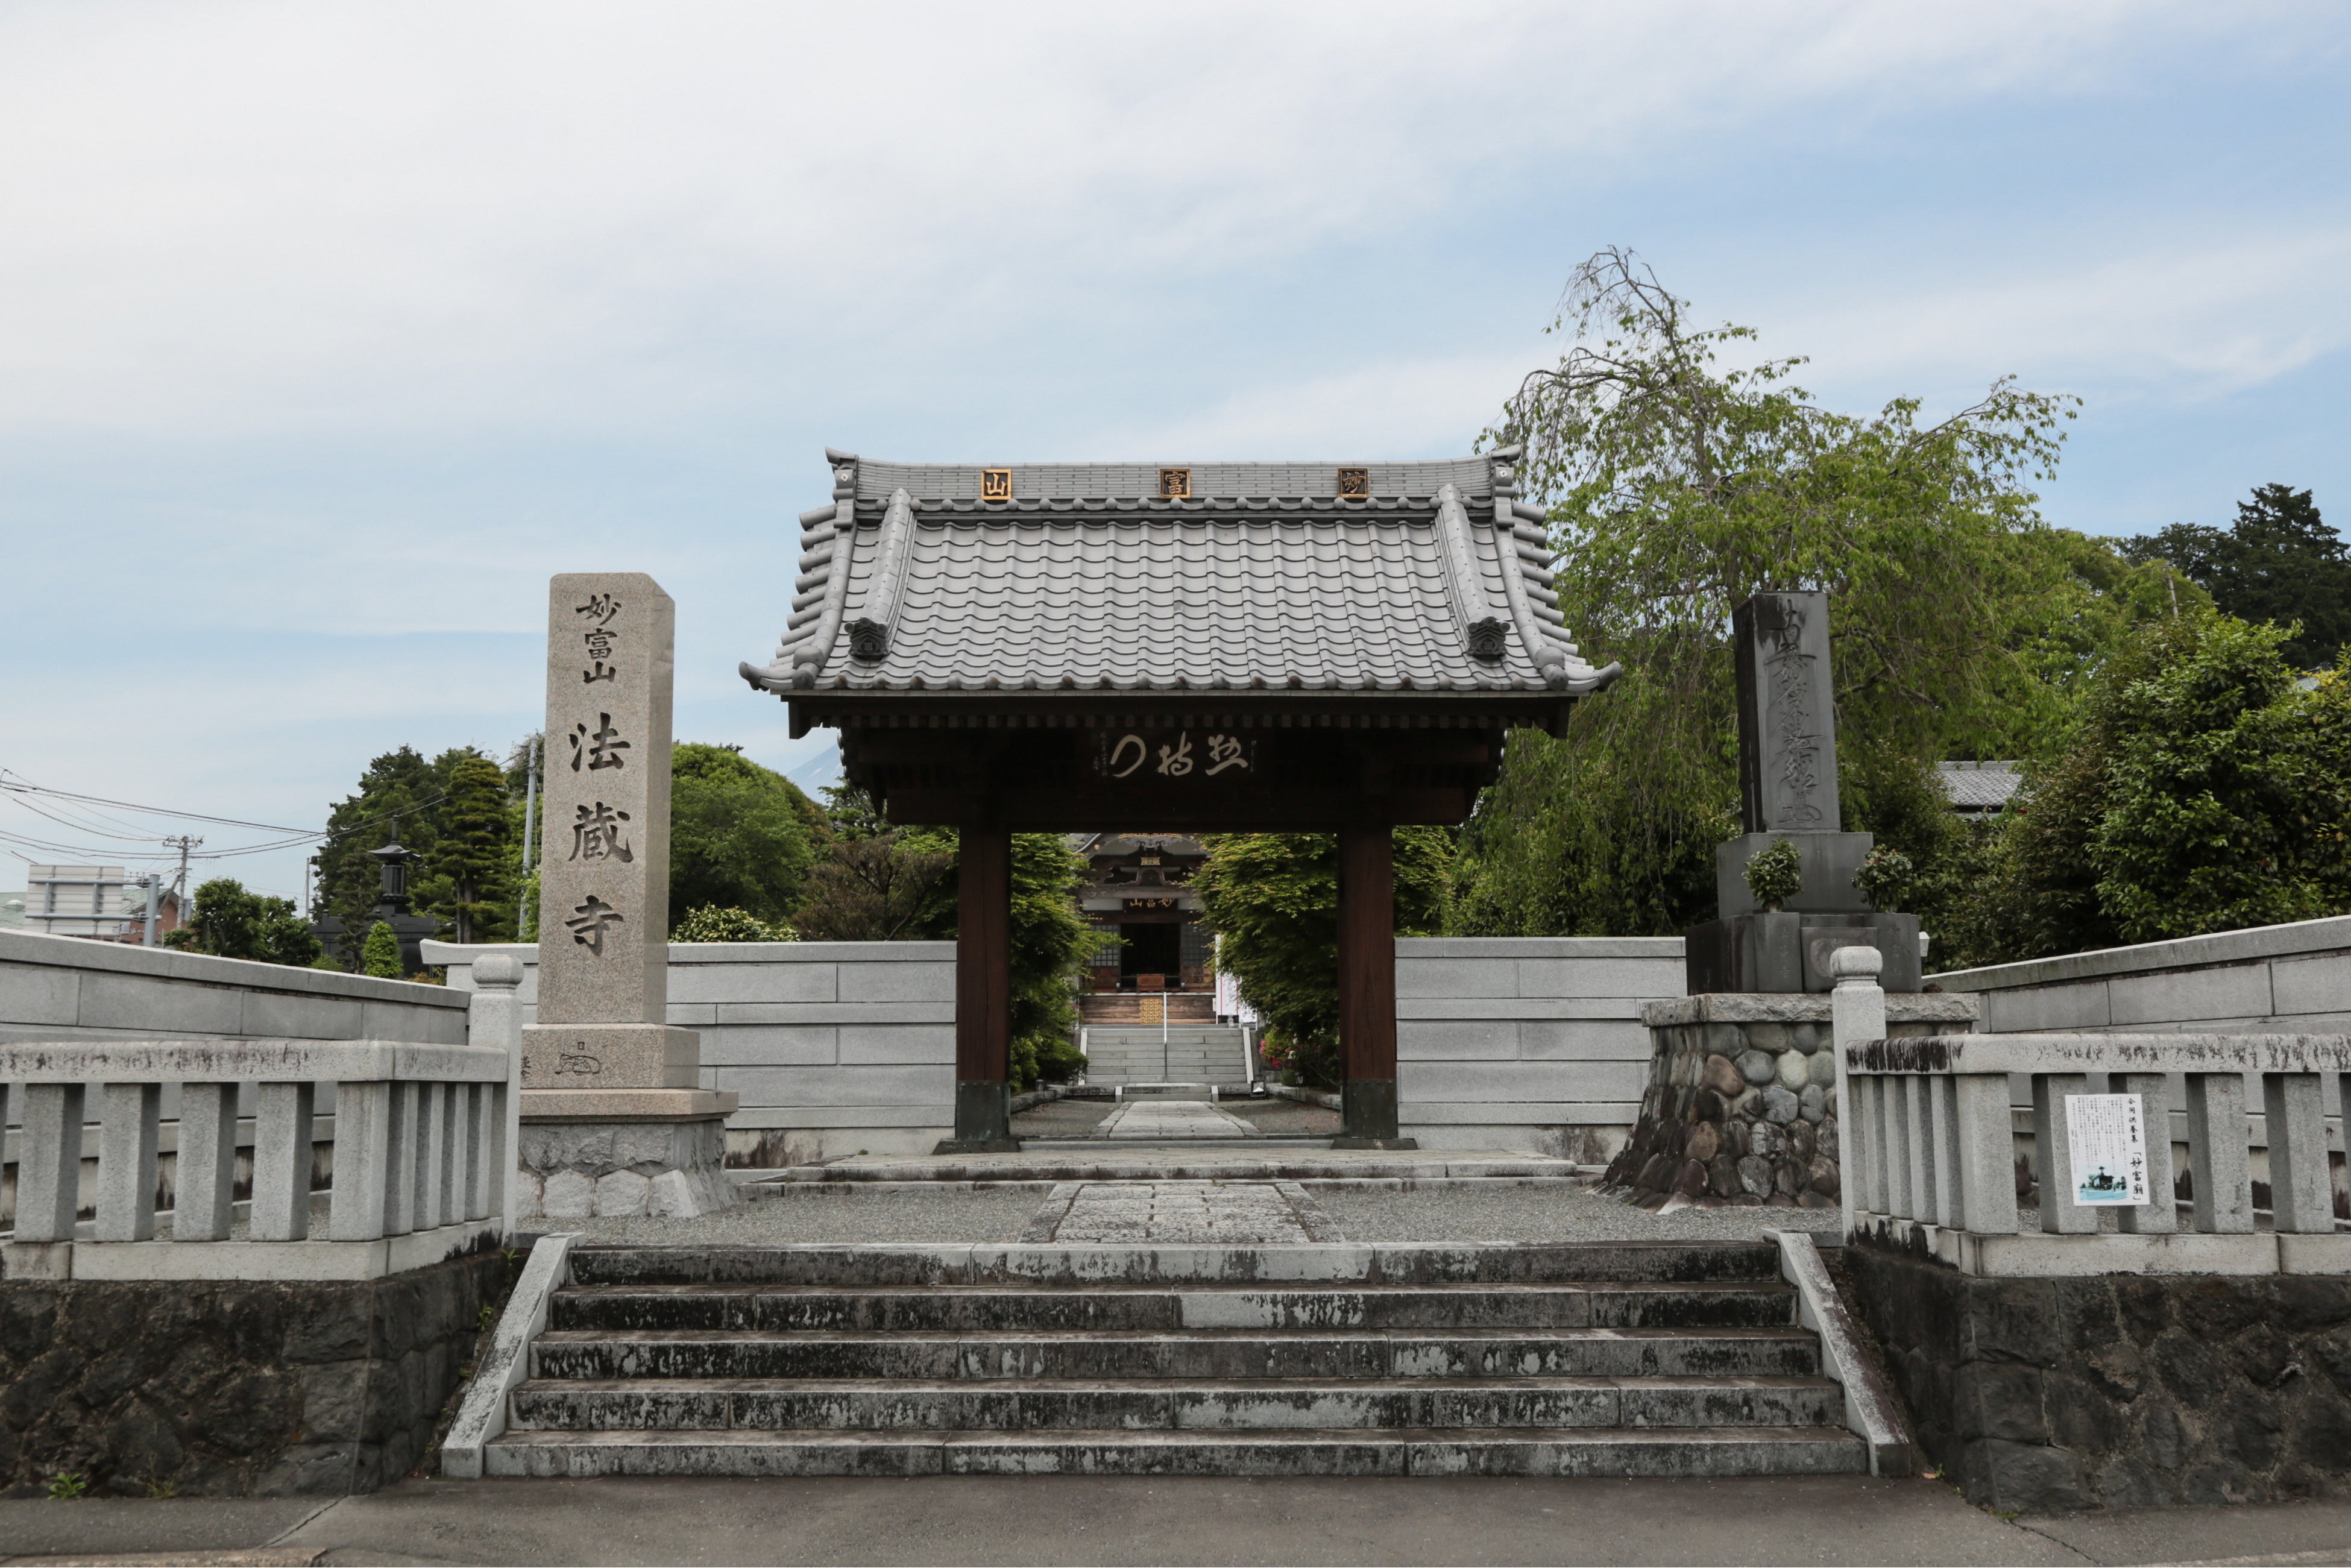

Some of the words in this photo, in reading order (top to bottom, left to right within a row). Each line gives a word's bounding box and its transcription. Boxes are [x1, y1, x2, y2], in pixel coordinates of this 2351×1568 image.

[575, 593, 622, 684] 妙富山
[564, 711, 634, 957] 法蔵寺
[2128, 1098, 2138, 1143] 合同供養墓
